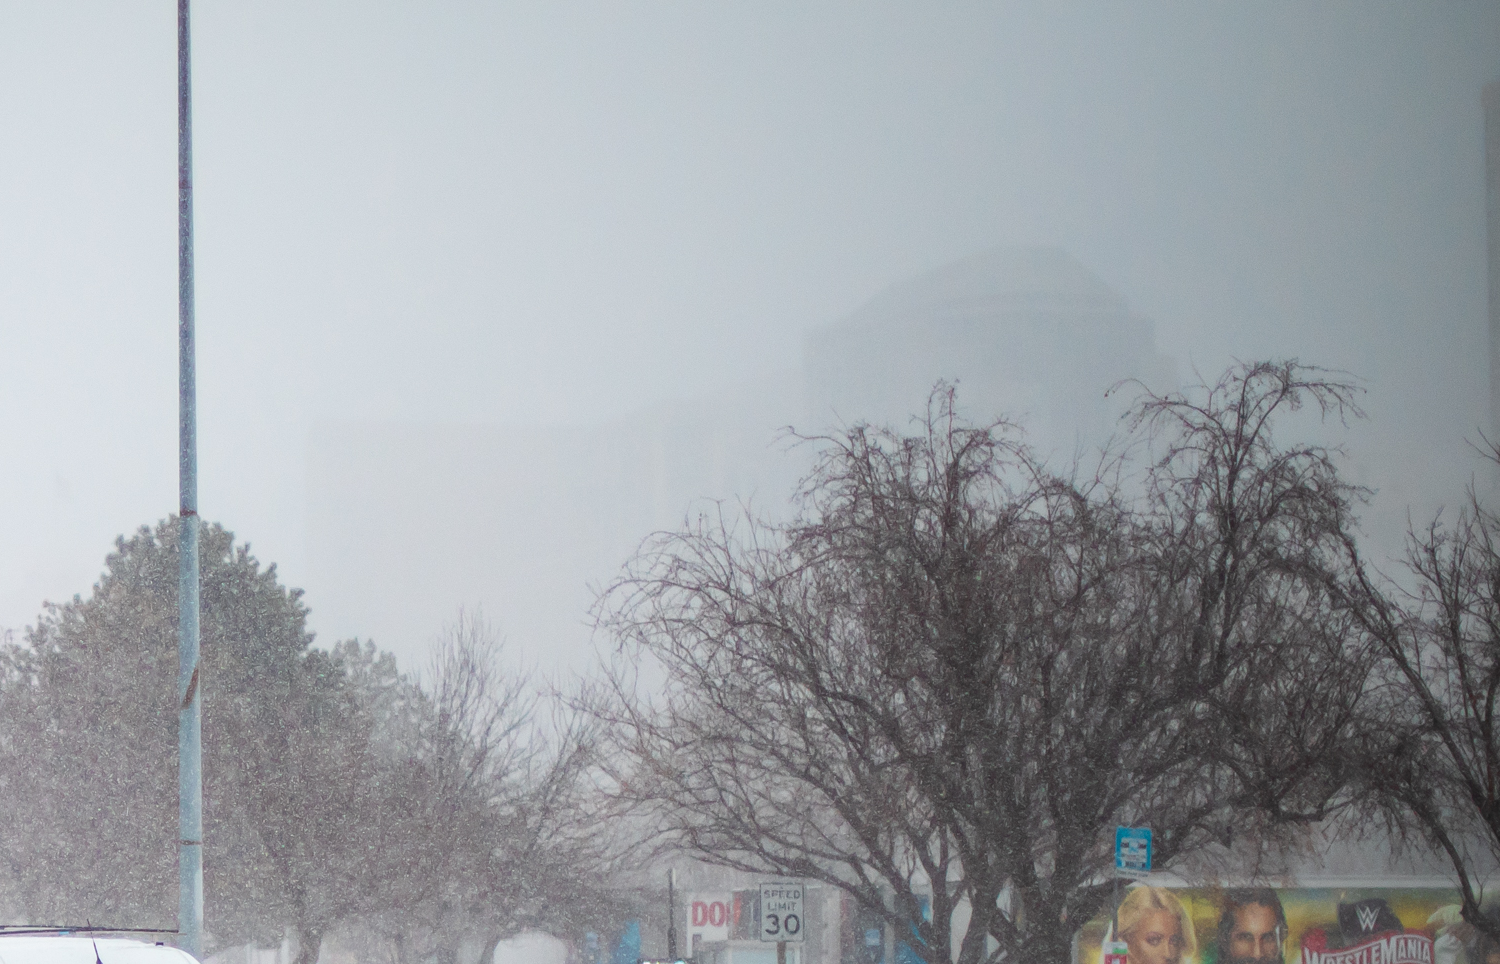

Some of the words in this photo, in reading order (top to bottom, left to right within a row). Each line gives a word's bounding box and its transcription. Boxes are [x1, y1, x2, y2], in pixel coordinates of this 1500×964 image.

[764, 889, 800, 899] SPEED
[692, 901, 730, 927] DO
[767, 902, 797, 911] LIMIT
[765, 914, 800, 935] 30
